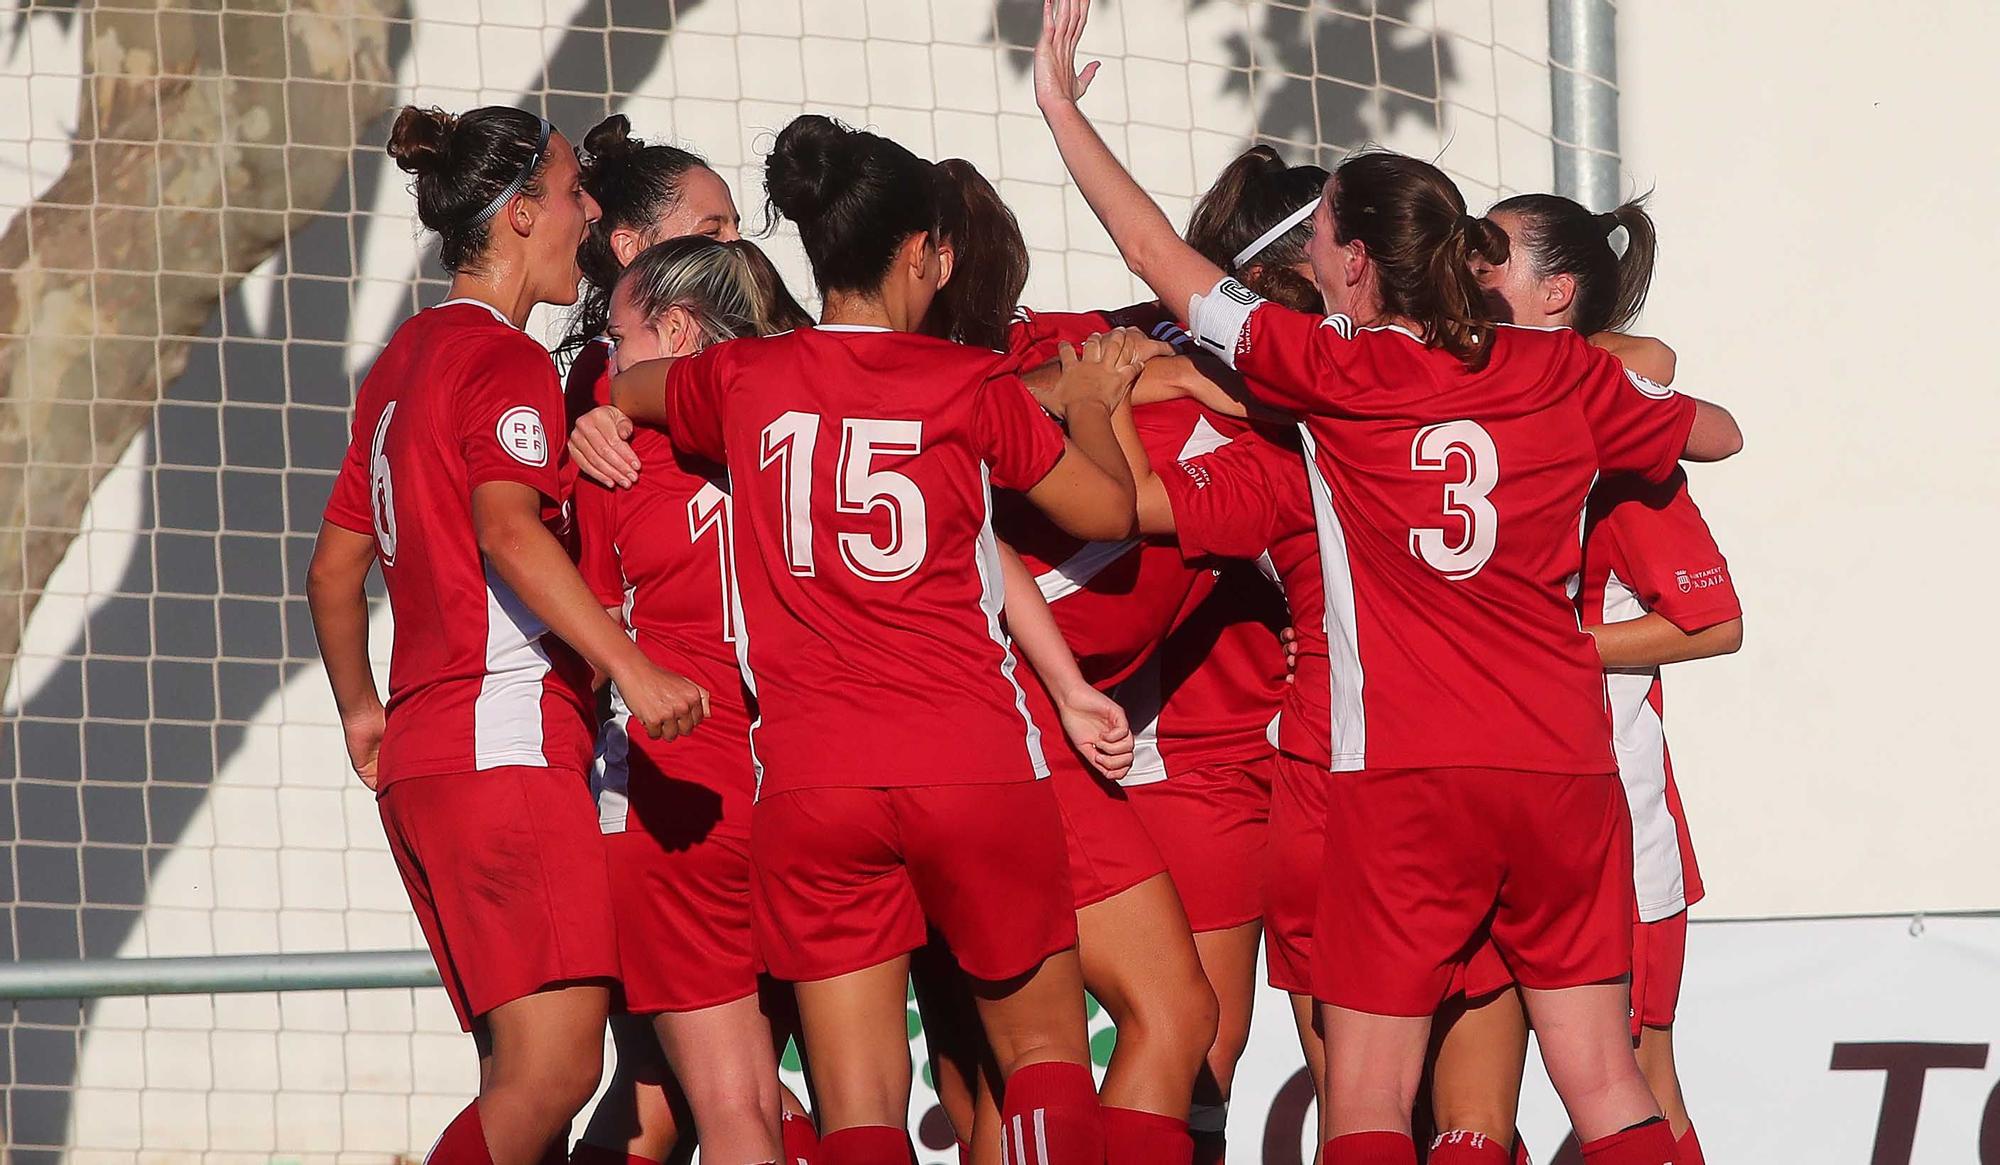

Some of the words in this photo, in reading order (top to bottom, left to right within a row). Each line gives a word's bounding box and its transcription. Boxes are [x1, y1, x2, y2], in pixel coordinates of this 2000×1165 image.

[370, 400, 397, 567] 6
[759, 410, 928, 582] 15
[1408, 419, 1499, 582] 3
